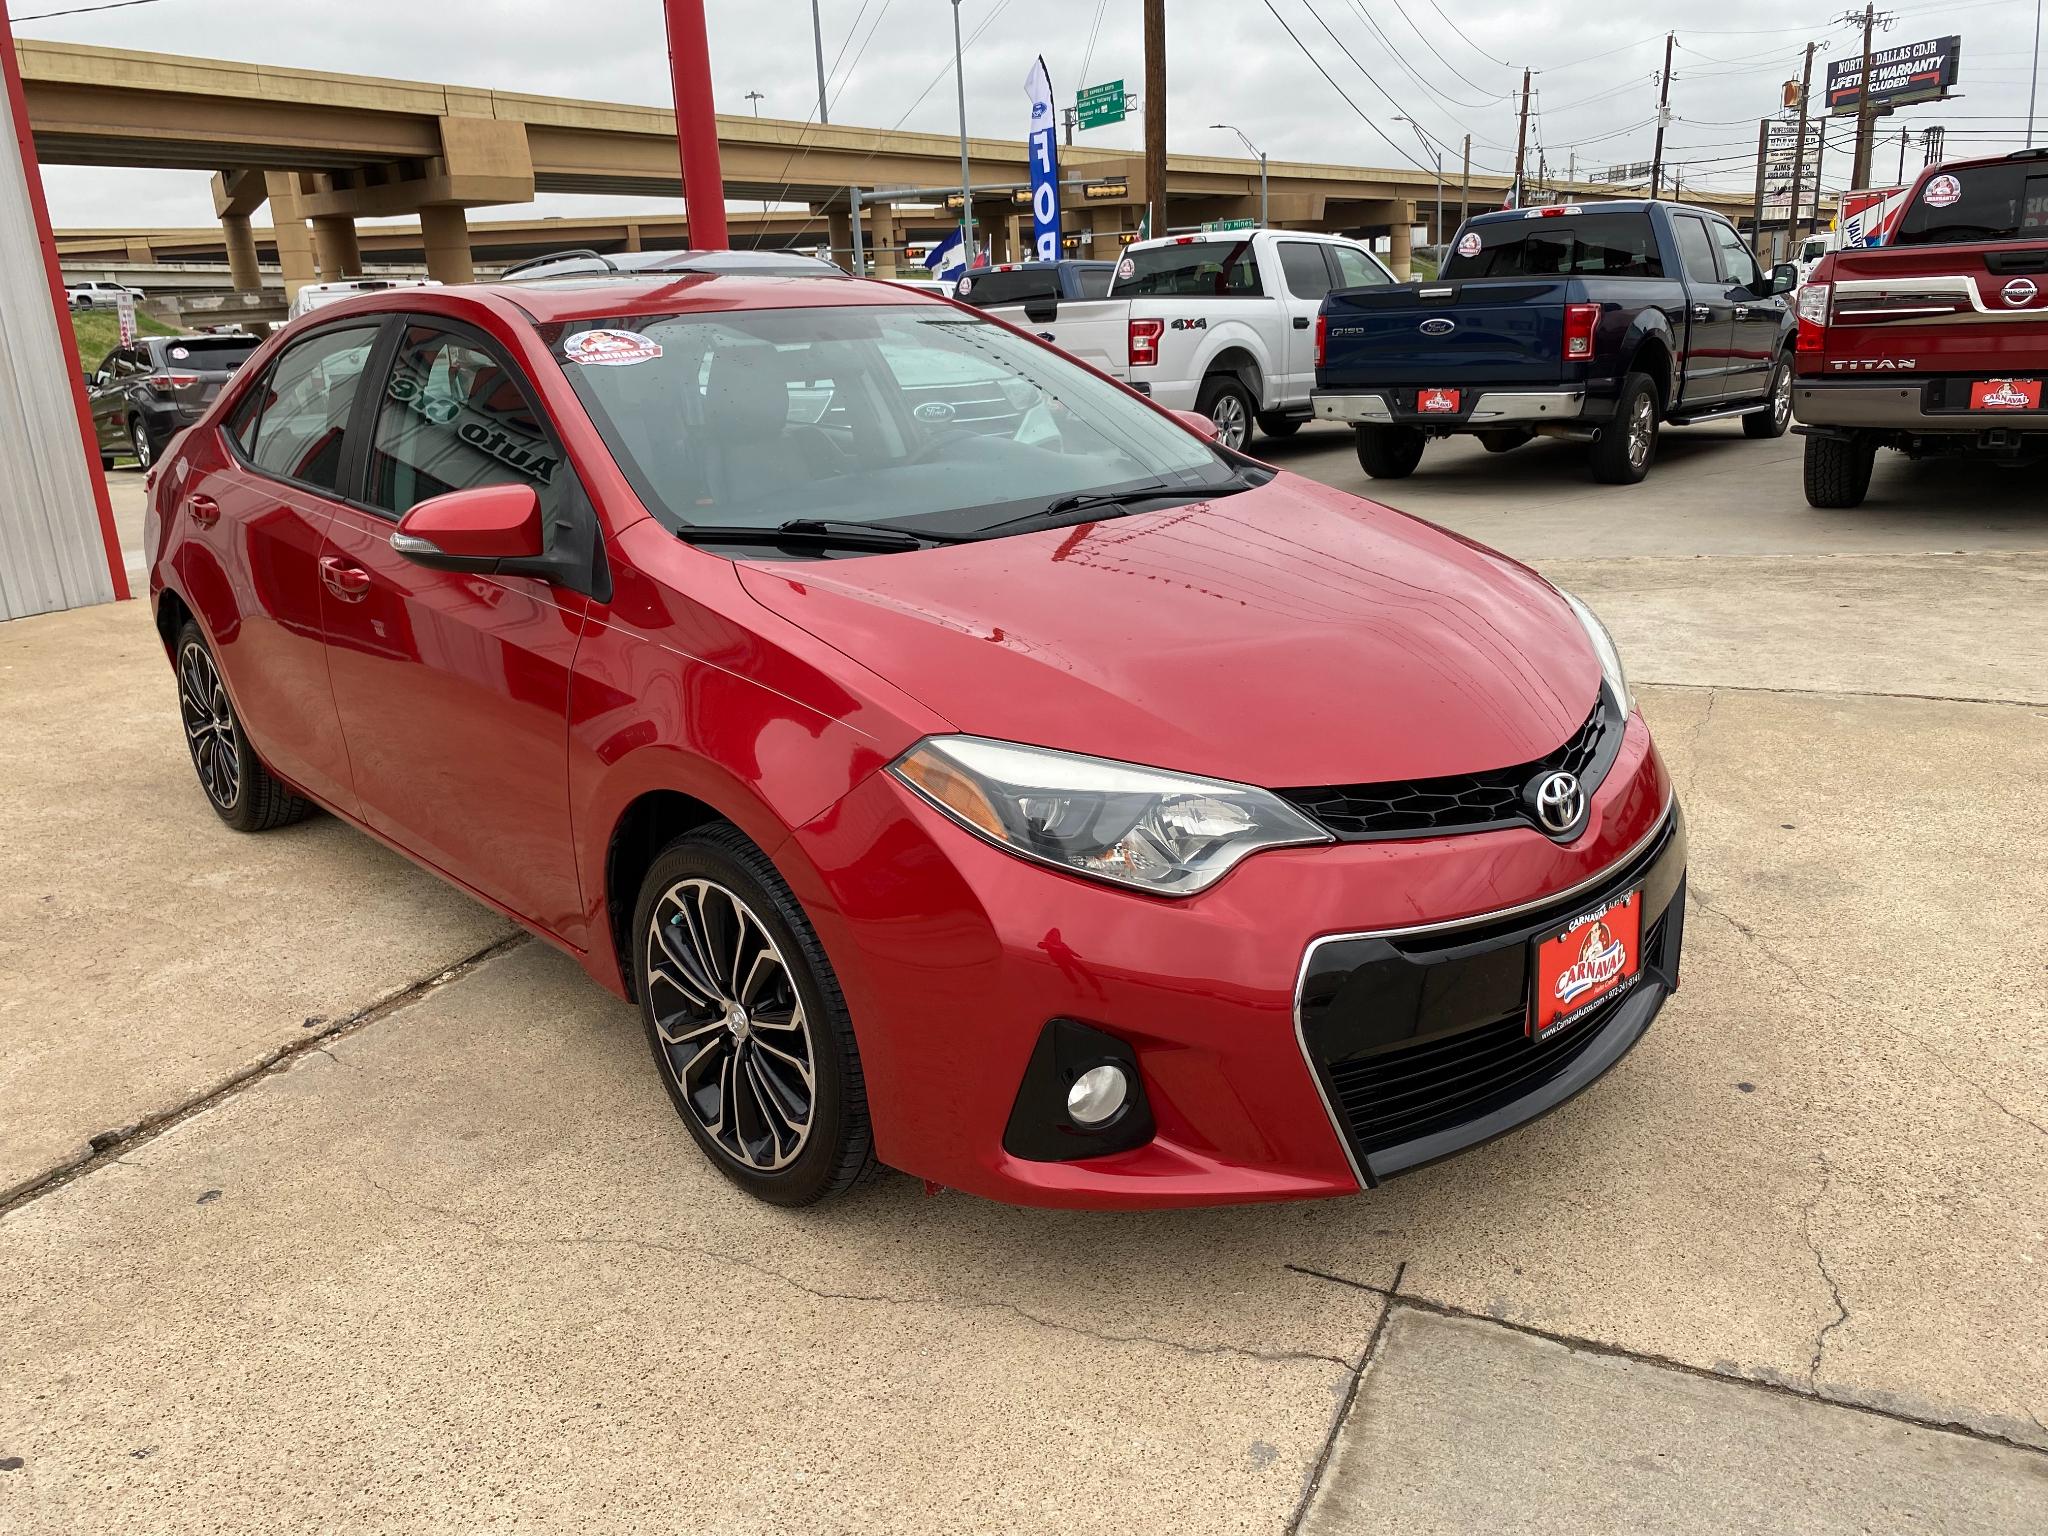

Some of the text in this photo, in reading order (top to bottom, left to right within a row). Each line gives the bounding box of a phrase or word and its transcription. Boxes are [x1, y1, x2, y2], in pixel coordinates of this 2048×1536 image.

[1838, 41, 1937, 74] NORT DALLAS CDJR
[1830, 55, 1945, 90] LIFETIE WARRANTY
[1868, 76, 1909, 92] CLUDED!
[1213, 222, 1232, 230] Hry
[1233, 219, 1253, 229] Hines
[580, 348, 655, 362] WARRANTY
[1830, 358, 1917, 370] TITAN
[1983, 393, 2028, 405] CARNAVAL
[1568, 904, 1608, 933] CARNAVAL
[1555, 946, 1625, 998] CARNAVAL
[1541, 996, 1605, 1040] www.CarnavalAutos.com
